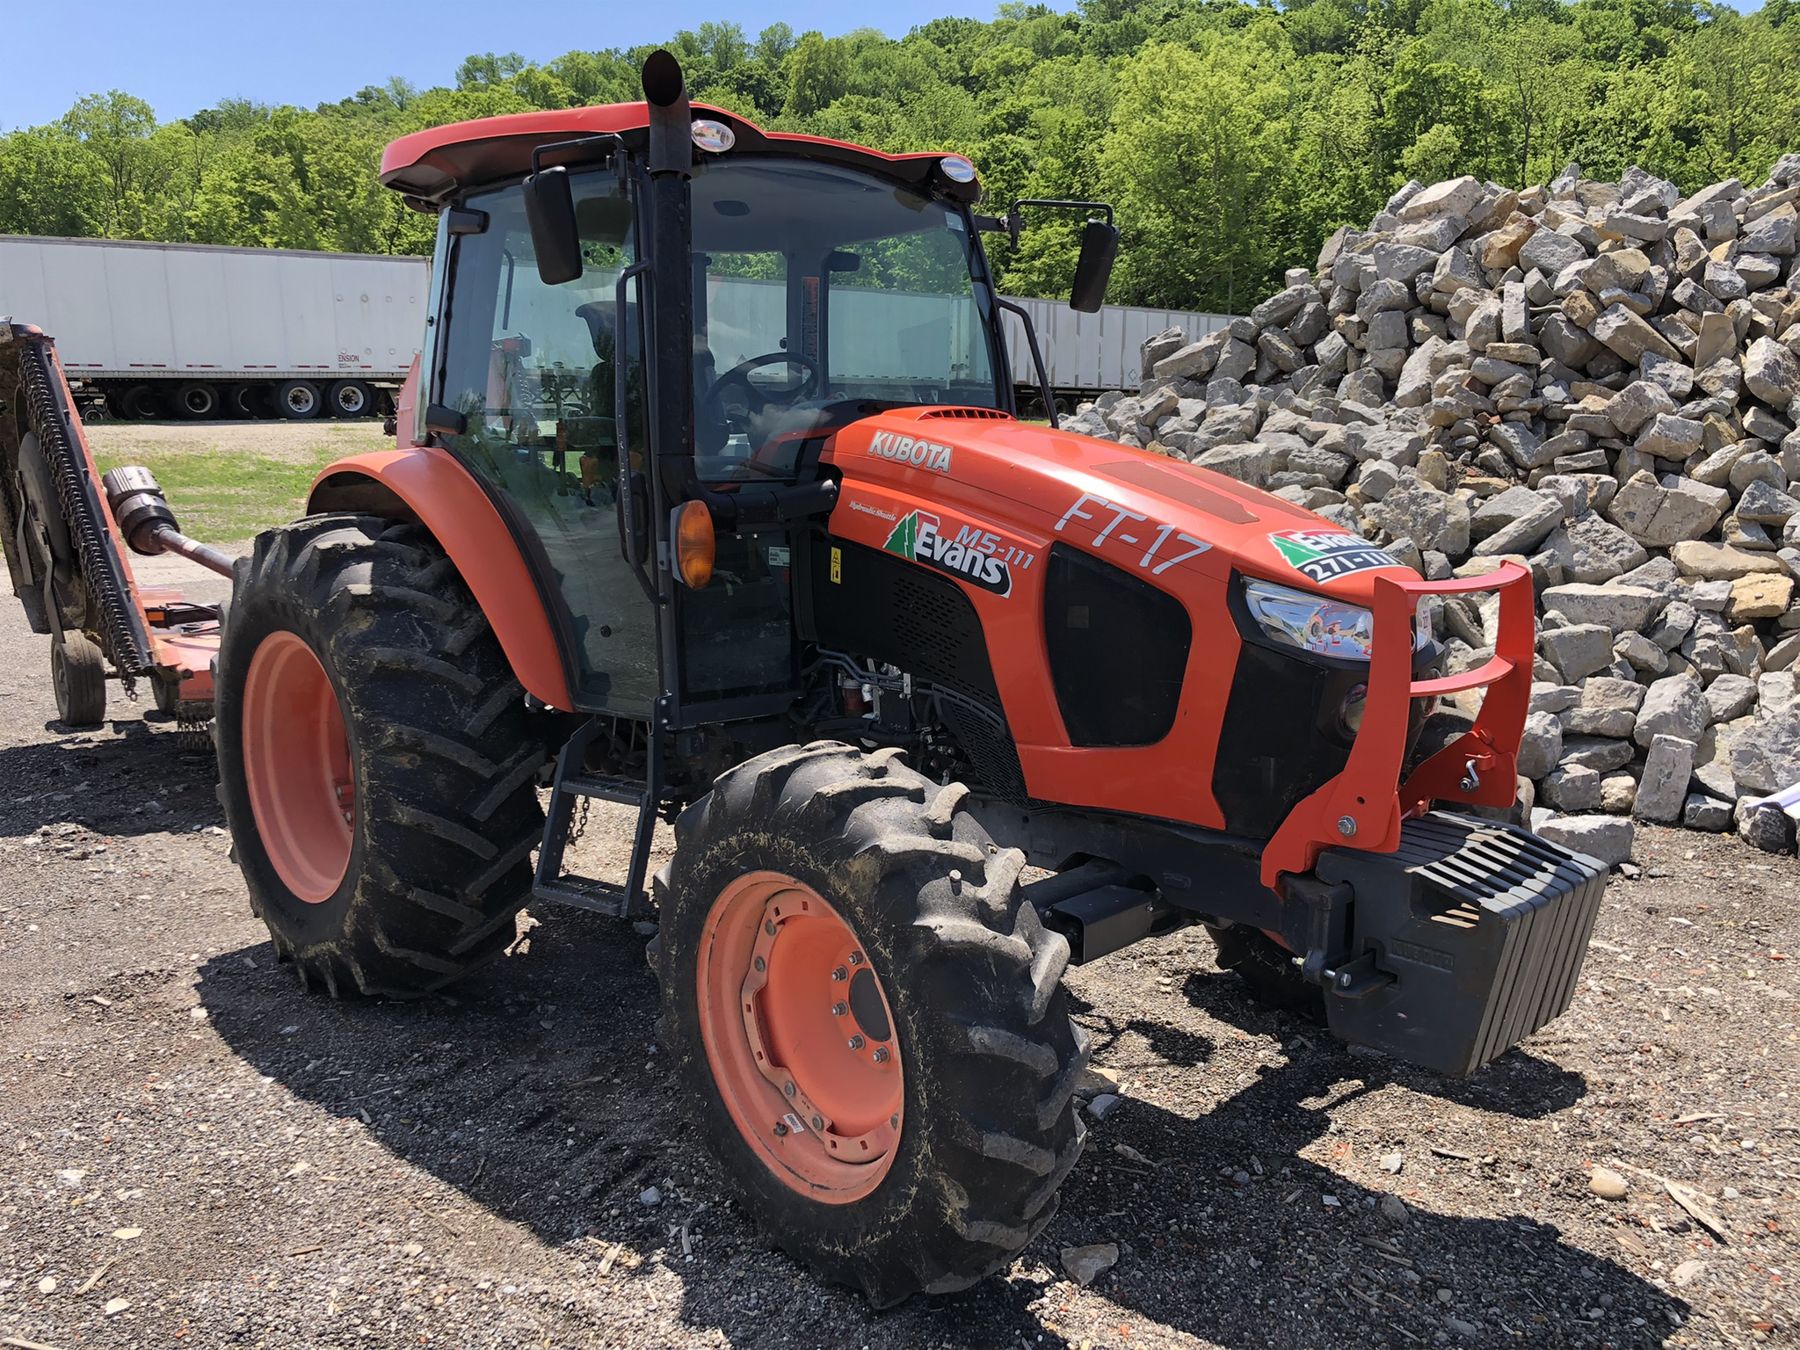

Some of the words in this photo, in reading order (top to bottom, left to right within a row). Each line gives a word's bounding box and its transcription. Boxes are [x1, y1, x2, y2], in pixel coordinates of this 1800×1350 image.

[868, 430, 952, 474] KUBOTA
[875, 508, 897, 521] Shuttle
[1054, 491, 1214, 575] FT-17
[915, 521, 1005, 585] Evans
[954, 525, 1035, 570] M5-111
[1286, 532, 1377, 552] Evan
